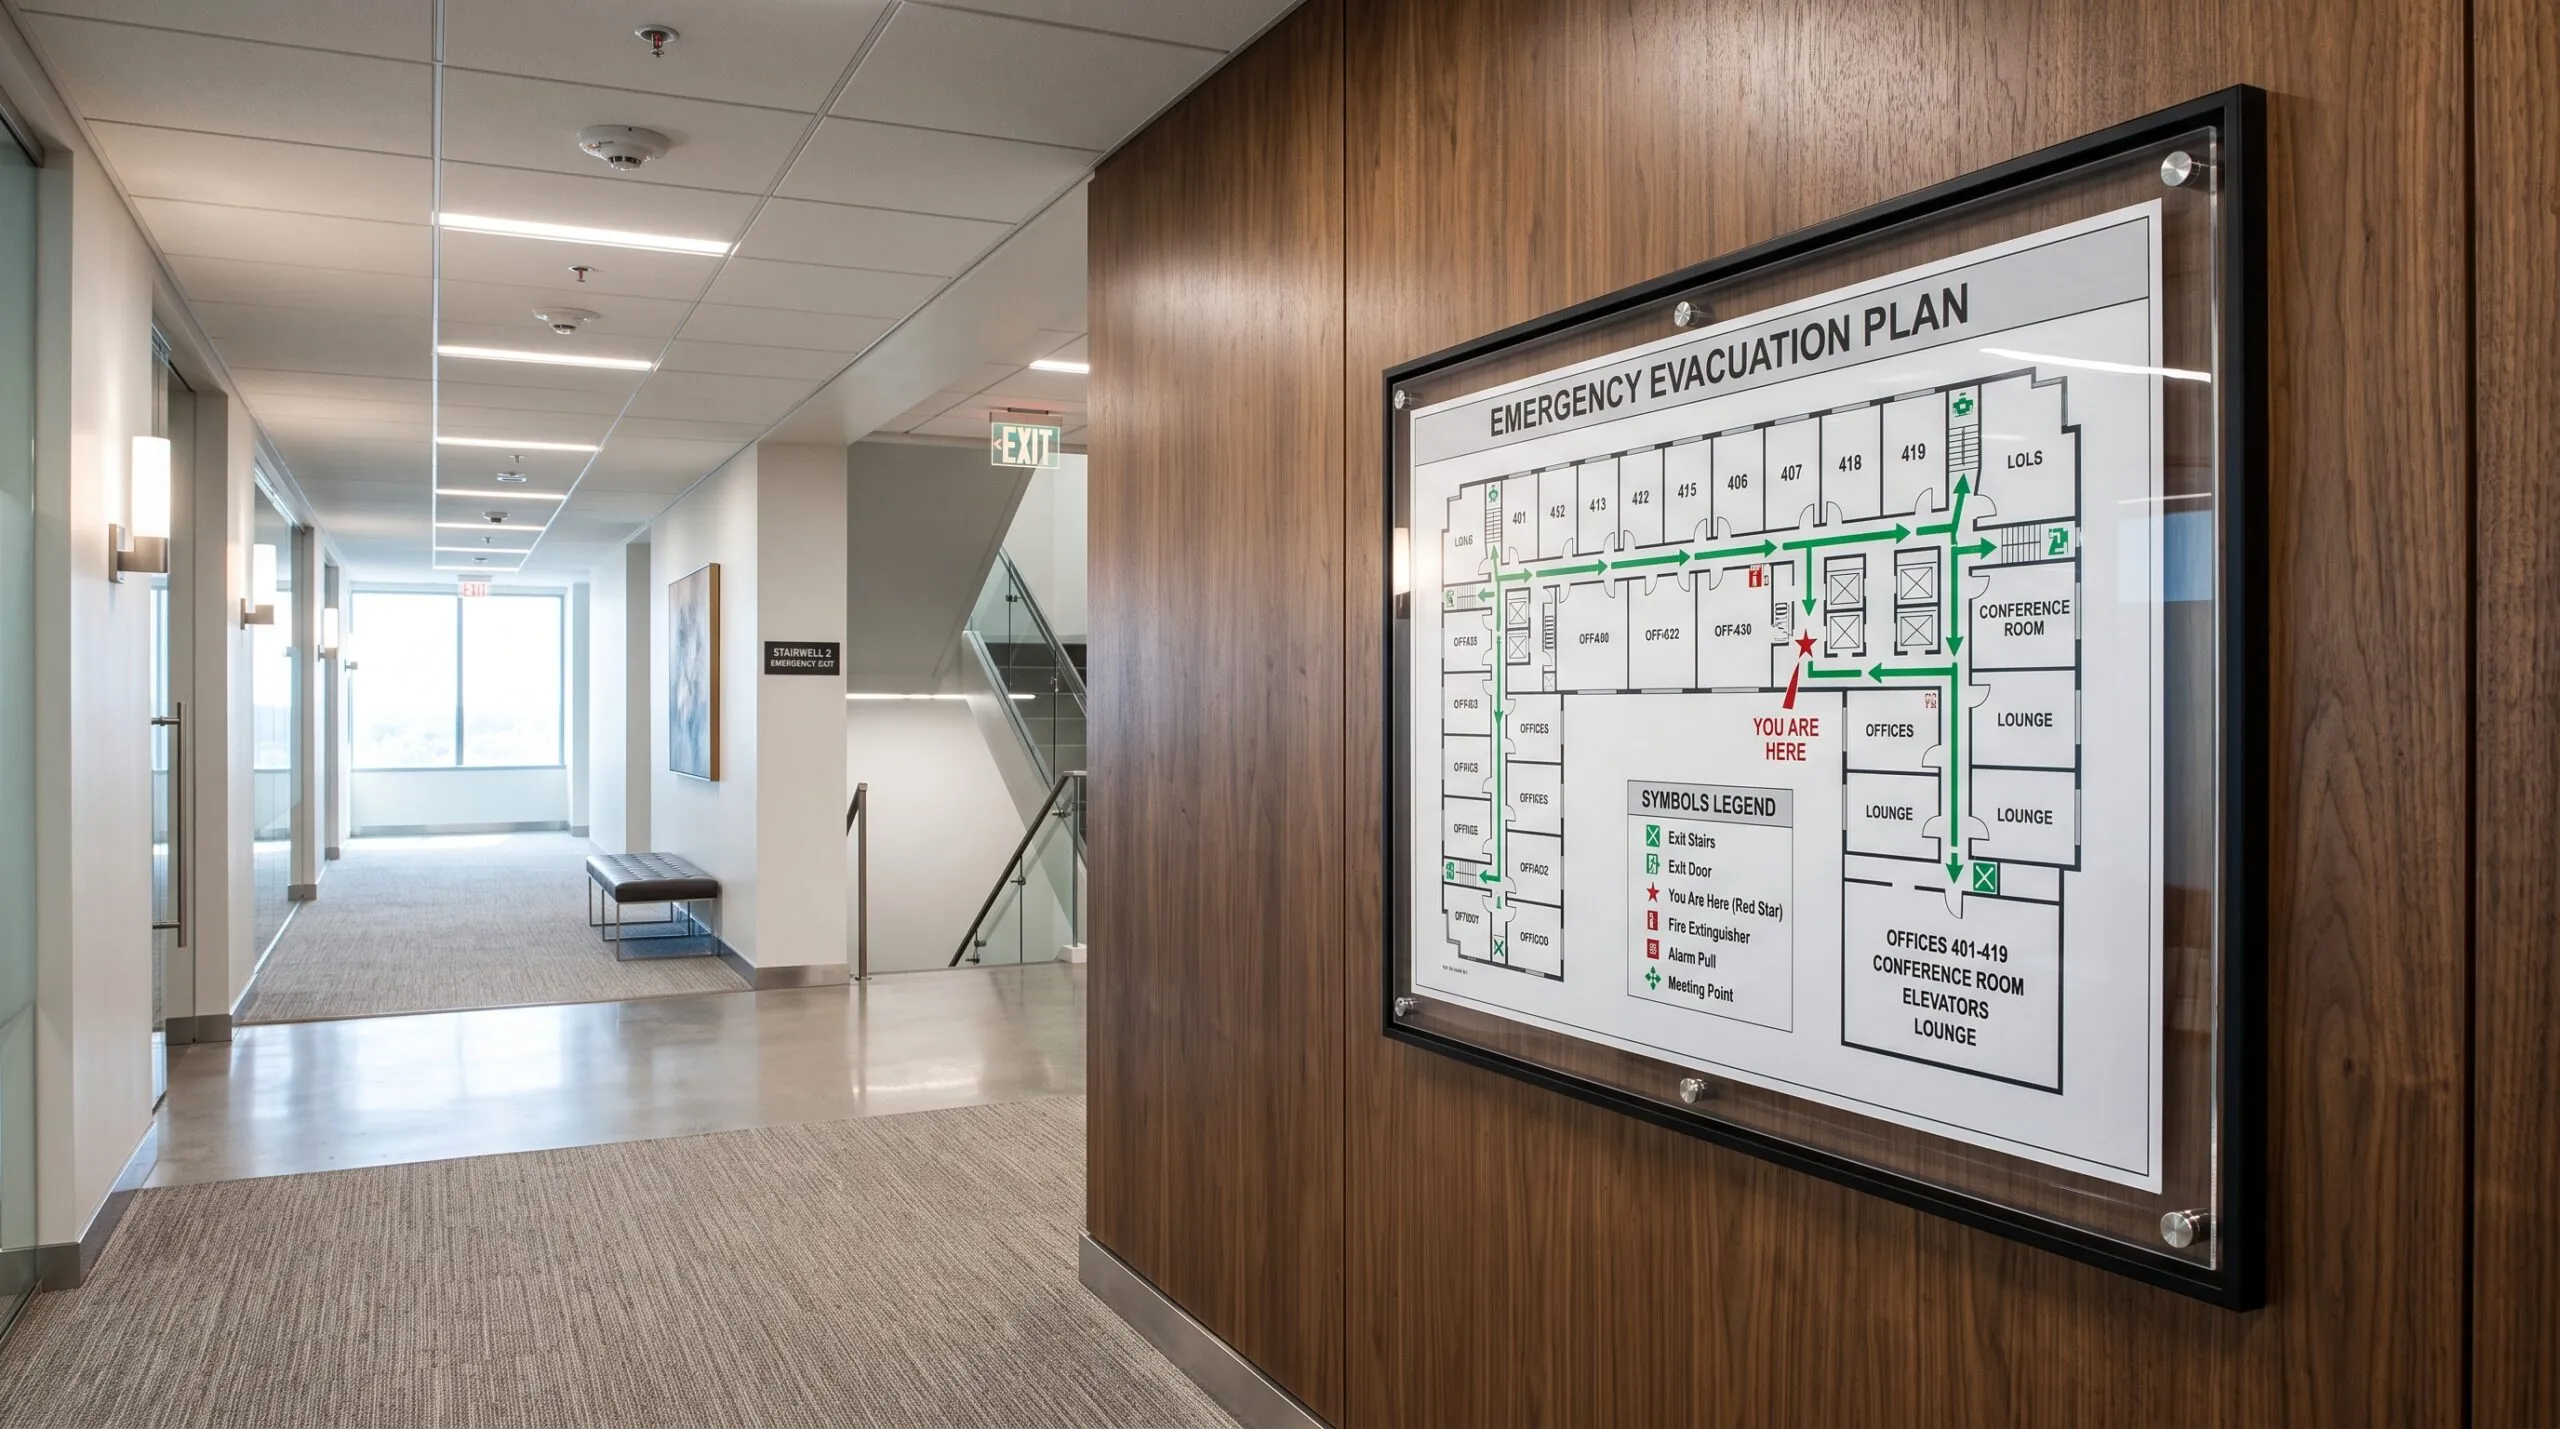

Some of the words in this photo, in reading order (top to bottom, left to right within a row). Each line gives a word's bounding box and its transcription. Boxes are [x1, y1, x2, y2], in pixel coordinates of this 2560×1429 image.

[1491, 370, 1642, 437] EMERGENCY
[1650, 315, 1850, 399] EVACUATION
[1864, 282, 1968, 347] PLAN
[1002, 426, 1052, 465] EXIT
[1902, 443, 1926, 462] 419
[1839, 455, 1862, 472] 418
[2008, 450, 2043, 469] LOLS
[1781, 464, 1802, 481] 407
[1678, 483, 1697, 498] 415
[1728, 474, 1748, 490] 406
[1550, 505, 1565, 518] 452
[1590, 498, 1606, 511] 413
[1512, 511, 1526, 524] 401
[1979, 600, 2070, 619] CONFERENCE
[2004, 621, 2045, 637] ROOM
[773, 648, 823, 657] STAIRWELL
[825, 649, 832, 658] 2
[770, 659, 816, 667] EMERGENCY
[1520, 723, 1549, 734] OFFICES
[1753, 718, 1784, 736] YOU
[1787, 718, 1819, 737] ARE
[1997, 712, 2053, 728] LOUNGE
[1866, 723, 1914, 738] OFFICES
[1766, 742, 1806, 761] HERE
[1642, 789, 1710, 812] SYMBOLS
[1713, 794, 1776, 817] LEGEND
[1866, 805, 1913, 821] LOUNGE
[1997, 808, 2053, 825] LOUNGE
[1668, 831, 1686, 846] Exit
[1688, 832, 1716, 849] Stairs
[1668, 860, 1686, 875] Exit
[1688, 862, 1712, 878] Door
[1668, 888, 1687, 904] You
[1688, 891, 1704, 906] Are
[1707, 893, 1729, 911] Here
[1732, 896, 1755, 915] (Red
[1758, 902, 1783, 922] Star)
[1668, 918, 1686, 933] Fire
[1688, 921, 1750, 944] Extinguisher
[1887, 929, 1947, 954] OFFICES
[1951, 939, 2008, 963] 401-419
[1668, 947, 1695, 965] Alarm
[1698, 951, 1716, 969] Pull
[1873, 954, 1971, 987] CONFERENCE
[1976, 971, 2024, 996] ROOM
[1668, 976, 1705, 1000] Meeting
[1707, 982, 1733, 1002] Point
[1903, 987, 1989, 1020] ELEVATORS
[1914, 1017, 1976, 1047] LOUNGE
